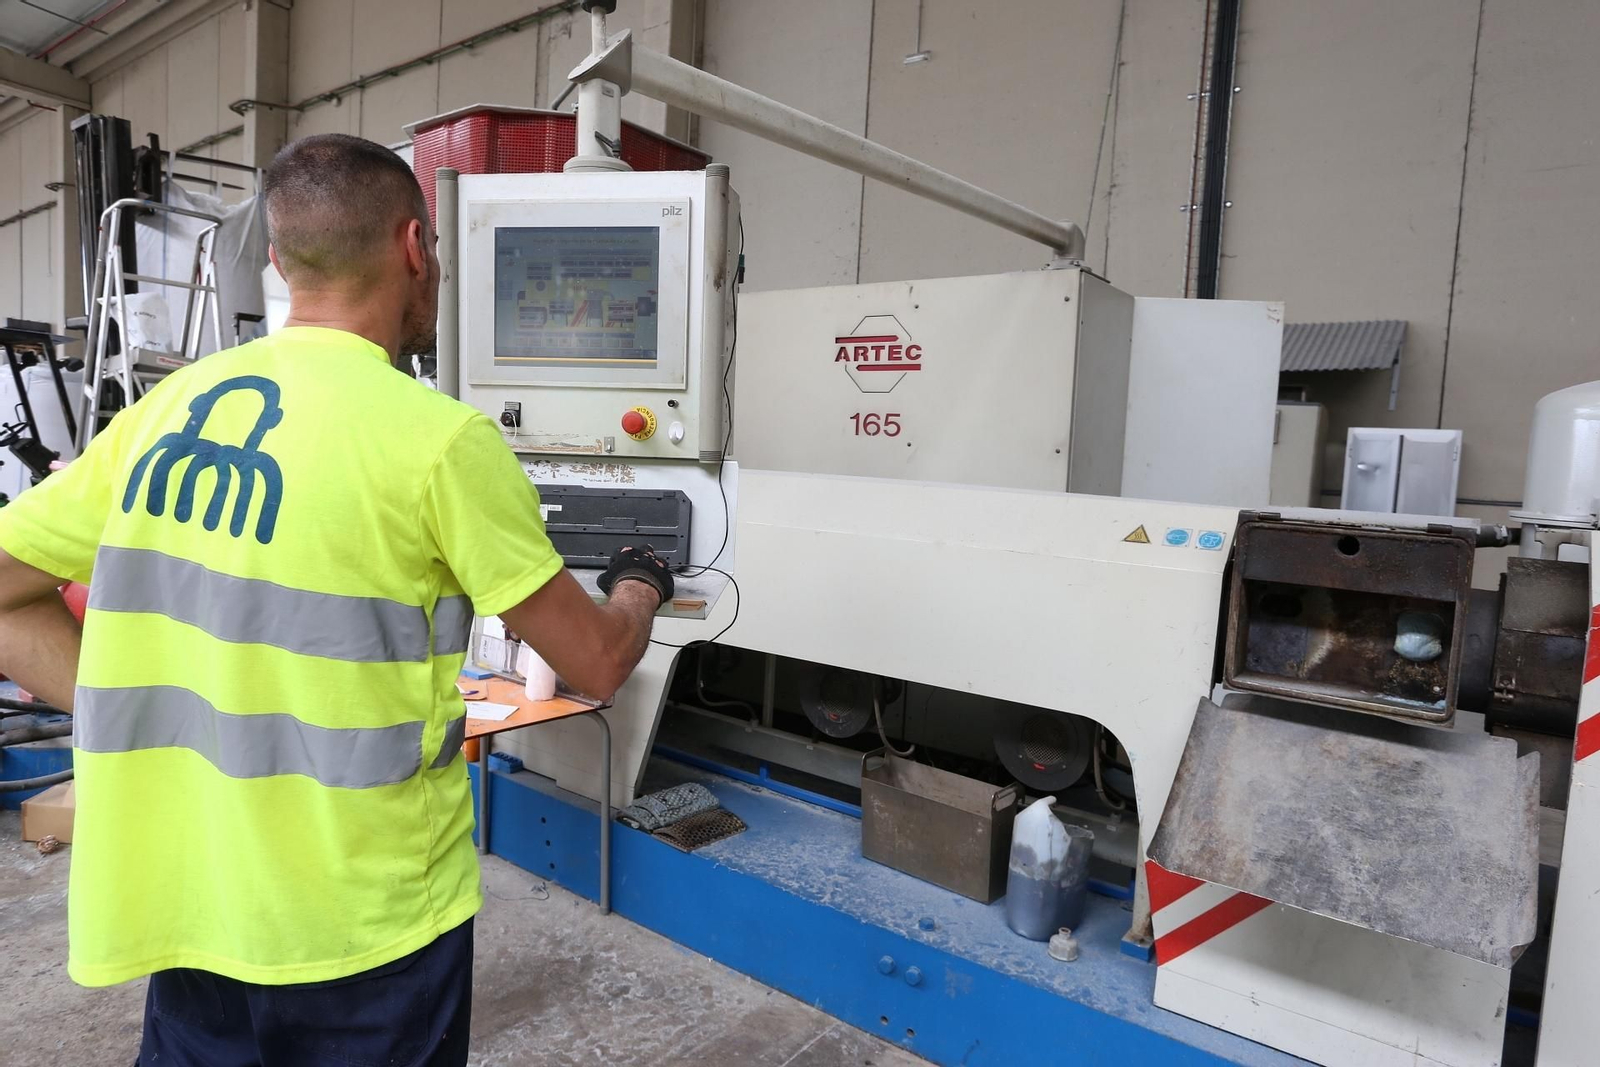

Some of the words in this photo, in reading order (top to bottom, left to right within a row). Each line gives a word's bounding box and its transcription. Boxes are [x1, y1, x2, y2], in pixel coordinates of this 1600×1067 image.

[662, 205, 682, 217] pilz
[834, 344, 922, 362] ARTEC
[636, 407, 655, 437] EMERGENCIA
[849, 412, 901, 437] 165
